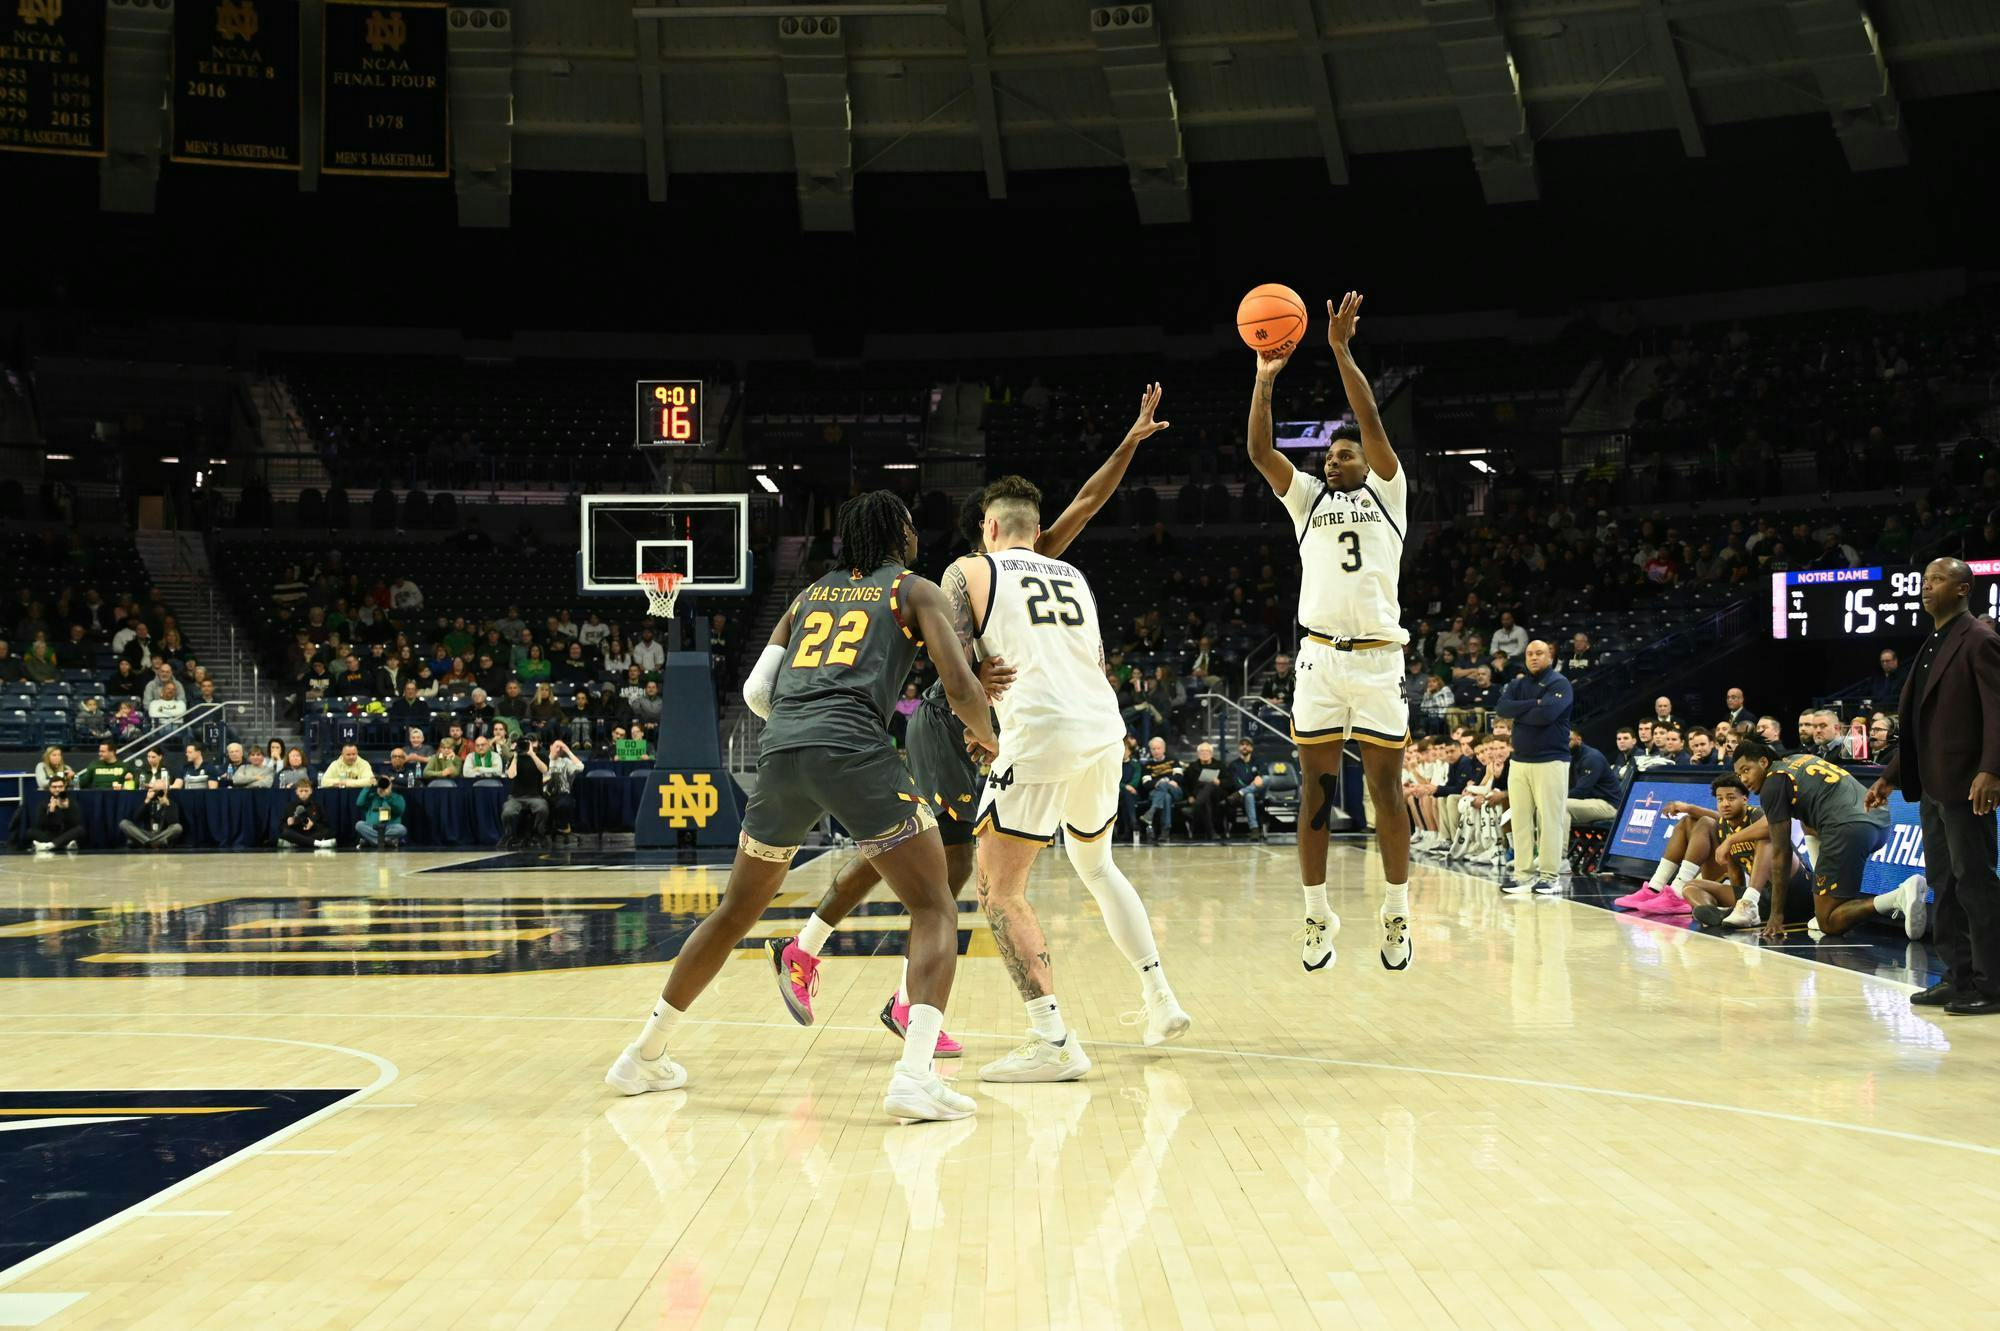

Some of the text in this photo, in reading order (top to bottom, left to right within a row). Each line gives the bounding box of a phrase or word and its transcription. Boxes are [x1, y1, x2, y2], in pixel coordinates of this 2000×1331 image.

[211, 45, 263, 63] NCAA
[198, 60, 277, 80] ELITE 8
[361, 57, 411, 71] NCAA
[333, 72, 438, 88] FINAL FOUR
[187, 80, 227, 99] 2016
[50, 110, 92, 128] 2015
[367, 113, 405, 129] 1978
[23, 129, 92, 146] BASKETBALL
[184, 140, 289, 160] MEN'S BASKETBALL
[335, 151, 435, 168] MEN'S BASKETBALL
[655, 386, 696, 406] 9:01
[662, 406, 691, 439] 16
[1312, 511, 1382, 528] NOTRE DAME
[1338, 531, 1363, 573] 3
[1797, 569, 1869, 583] NOTRE DAME
[1891, 572, 1922, 597] 9:0
[808, 586, 883, 603] HASTINGS
[1020, 577, 1085, 627] 25
[1844, 588, 1877, 634] 15
[791, 609, 871, 669] 22
[208, 728, 219, 738] 13
[343, 728, 354, 738] 14
[1248, 721, 1259, 731] 16
[625, 740, 637, 748] GO
[659, 774, 718, 828] ND
[1870, 823, 1926, 868] ATHL
